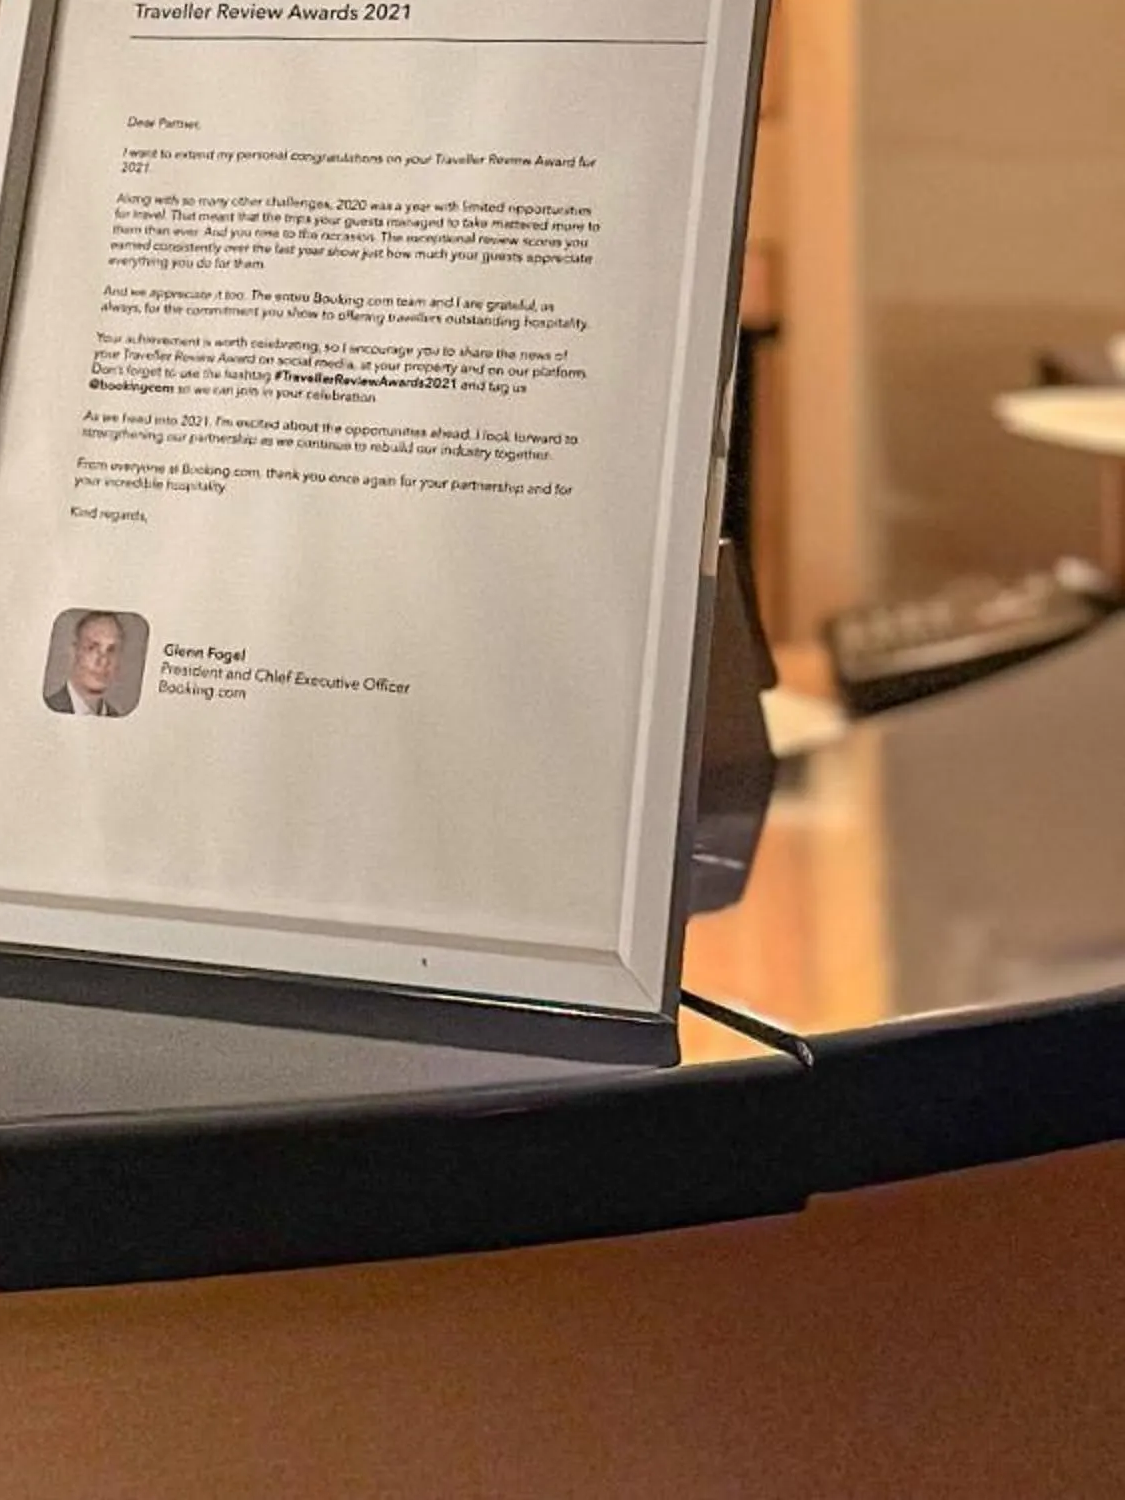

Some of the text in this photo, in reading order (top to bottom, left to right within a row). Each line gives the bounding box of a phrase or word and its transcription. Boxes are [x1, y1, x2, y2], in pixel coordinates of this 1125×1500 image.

[135, 3, 410, 20] Traveller Review Awards 2021
[126, 115, 155, 127] Dear
[128, 148, 157, 158] want
[159, 148, 172, 159] to
[174, 149, 215, 159] extend
[216, 151, 234, 163] my
[236, 149, 287, 163] personal
[385, 155, 402, 163] on
[404, 155, 432, 166] your
[435, 152, 485, 165] Traveller
[488, 153, 531, 166] Review
[534, 154, 576, 167] Award
[578, 155, 596, 168] for
[154, 194, 179, 204] with
[181, 196, 196, 205] so
[198, 197, 229, 208] many
[230, 196, 262, 207] other
[335, 197, 367, 209] 2020
[369, 201, 393, 210] was
[404, 203, 431, 213] year
[433, 200, 459, 212] with
[462, 199, 505, 213] limited
[114, 206, 600, 232] for That meant that the your guests managed to take to
[144, 224, 588, 250] than And you to the The review you
[152, 241, 221, 255] consistently
[223, 244, 249, 253] over
[251, 242, 272, 254] the
[274, 242, 296, 255] last
[297, 246, 325, 258] year
[326, 244, 359, 257] show
[360, 246, 384, 260] just
[386, 245, 411, 258] how
[414, 247, 448, 260] much
[449, 250, 478, 263] your
[481, 251, 523, 264] guests
[171, 256, 231, 270] you do for
[102, 284, 128, 297] And
[130, 288, 147, 297] we
[251, 289, 272, 302] The
[395, 294, 426, 307] team
[429, 295, 454, 308] and
[462, 299, 484, 309] are
[143, 301, 160, 314] for
[162, 302, 183, 315] the
[260, 308, 284, 321] you
[286, 306, 318, 319] show
[321, 308, 335, 320] to
[337, 309, 385, 325] offering
[444, 314, 520, 330] outstanding
[214, 336, 247, 349] worth
[323, 342, 340, 353] so
[415, 346, 440, 359] you
[441, 345, 456, 357] to
[495, 347, 516, 360] the
[519, 351, 551, 361] news
[93, 347, 529, 376] your Traveller Award on social your property and on our
[125, 363, 527, 395] forget #TravellerReviewAwards2021 and tag us
[193, 386, 211, 395] we
[212, 386, 233, 396] can
[275, 389, 303, 401] your
[101, 413, 119, 423] we
[282, 419, 319, 432] about
[321, 421, 342, 434] the
[513, 431, 562, 444] forward
[166, 433, 491, 460] our we continue our industry
[74, 476, 101, 488] your
[265, 467, 300, 481] thank
[301, 471, 326, 484] you
[328, 473, 360, 484] once
[362, 476, 396, 488] again
[399, 473, 417, 487] for
[419, 478, 449, 490] your
[526, 481, 552, 494] and
[554, 483, 572, 495] for
[70, 505, 98, 519] Kind
[164, 644, 245, 664] Glenn Fogel
[161, 662, 410, 693] President and Chief Executive Officer
